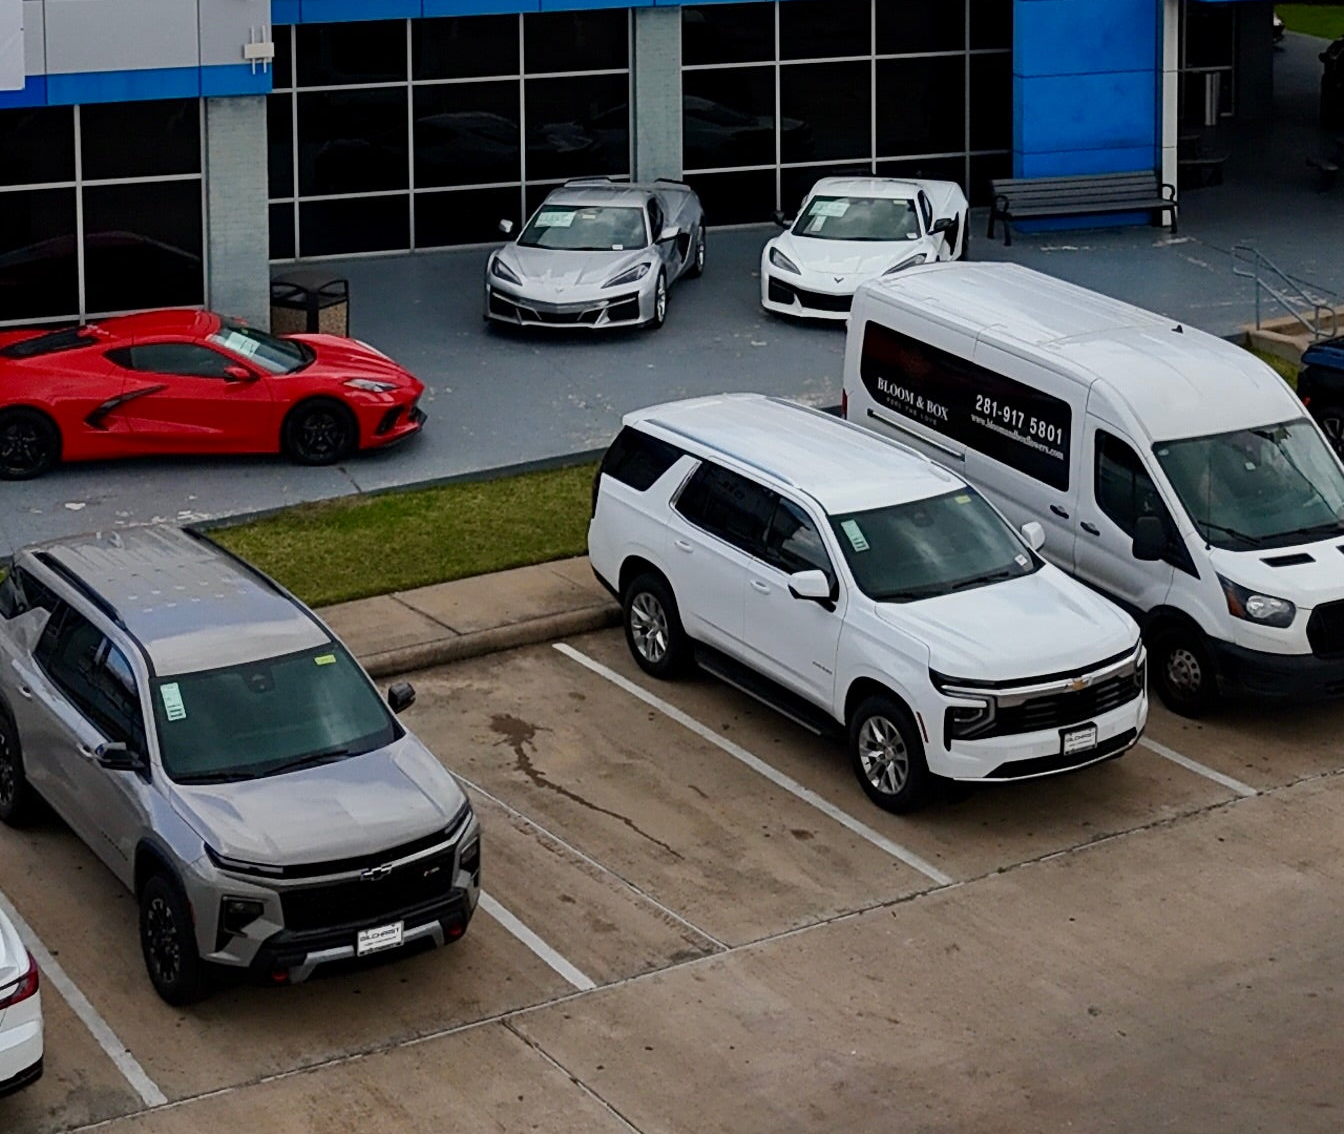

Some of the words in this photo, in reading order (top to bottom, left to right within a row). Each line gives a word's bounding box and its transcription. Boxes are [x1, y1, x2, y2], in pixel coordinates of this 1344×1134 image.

[877, 377, 915, 405] BLOOM
[916, 395, 924, 410] &
[926, 399, 949, 421] BOX
[975, 394, 1025, 428] 281-917
[1029, 417, 1062, 445] 5801
